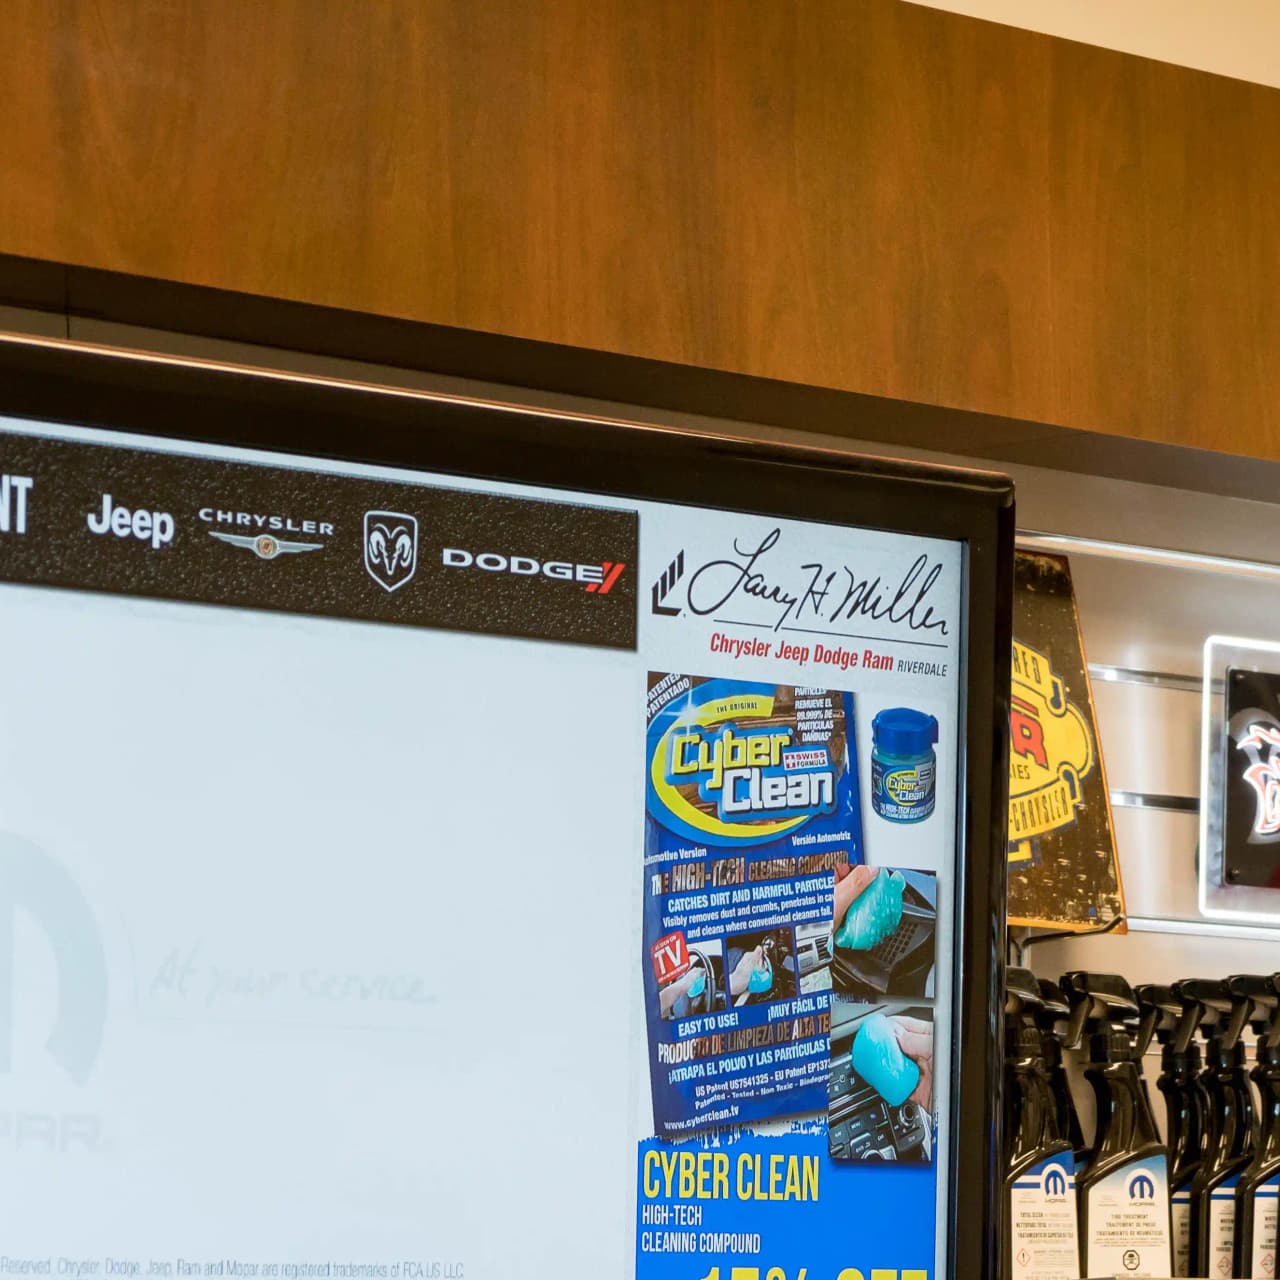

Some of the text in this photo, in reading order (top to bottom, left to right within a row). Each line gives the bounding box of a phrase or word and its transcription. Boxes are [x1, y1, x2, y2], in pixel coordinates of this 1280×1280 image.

[87, 494, 175, 549] Jeep
[198, 506, 334, 537] CHRYSLER
[442, 547, 605, 586] DODGE
[687, 527, 797, 633] Larry
[829, 553, 949, 635] Miller
[710, 633, 947, 678] Chrysler Jeep Dodge Ram RIVERDALE
[672, 730, 791, 789] Cyber
[724, 768, 833, 813] Clean
[679, 847, 707, 859] Version
[672, 857, 745, 892] HIGH-TECH
[749, 858, 795, 882] CLEANING
[663, 914, 687, 928] Visibly
[689, 911, 719, 923] removes
[720, 908, 736, 918] dust
[738, 905, 750, 915] and
[781, 895, 816, 910] penetrates
[668, 882, 794, 912] CATCHES DIRT AND HARMFUL
[687, 926, 701, 938] and
[702, 923, 725, 936] cleans
[726, 920, 747, 932] where
[748, 912, 790, 929] conventional
[792, 908, 819, 922] cleaners
[655, 940, 682, 975] TV
[792, 997, 815, 1015] FÁCIL
[817, 996, 829, 1009] DE
[658, 1016, 816, 1064] PRODUCTO DE LIMPIEZA DE ALTA
[678, 1013, 739, 1037] EASY TO USE!
[707, 1063, 717, 1075] EL
[719, 1055, 746, 1073] POLVO
[748, 1054, 755, 1068] Y
[756, 1051, 773, 1066] LAS
[774, 1039, 825, 1062] PARTÍCULAS
[695, 1094, 726, 1110] Patented
[731, 1088, 754, 1099] Tested
[775, 1082, 794, 1093] Toxic
[696, 1085, 705, 1097] US
[706, 1080, 728, 1095] Patent
[774, 1069, 784, 1081] EU
[785, 1065, 807, 1079] Patent
[664, 1105, 739, 1131] www.cyberclean.tv
[643, 1150, 819, 1201] CYBER CLEAN
[642, 1204, 702, 1226] HIGH-TECH
[641, 1232, 761, 1254] CLEANING COMPOUND
[403, 1262, 424, 1278] FCA
[426, 1262, 440, 1279] US
